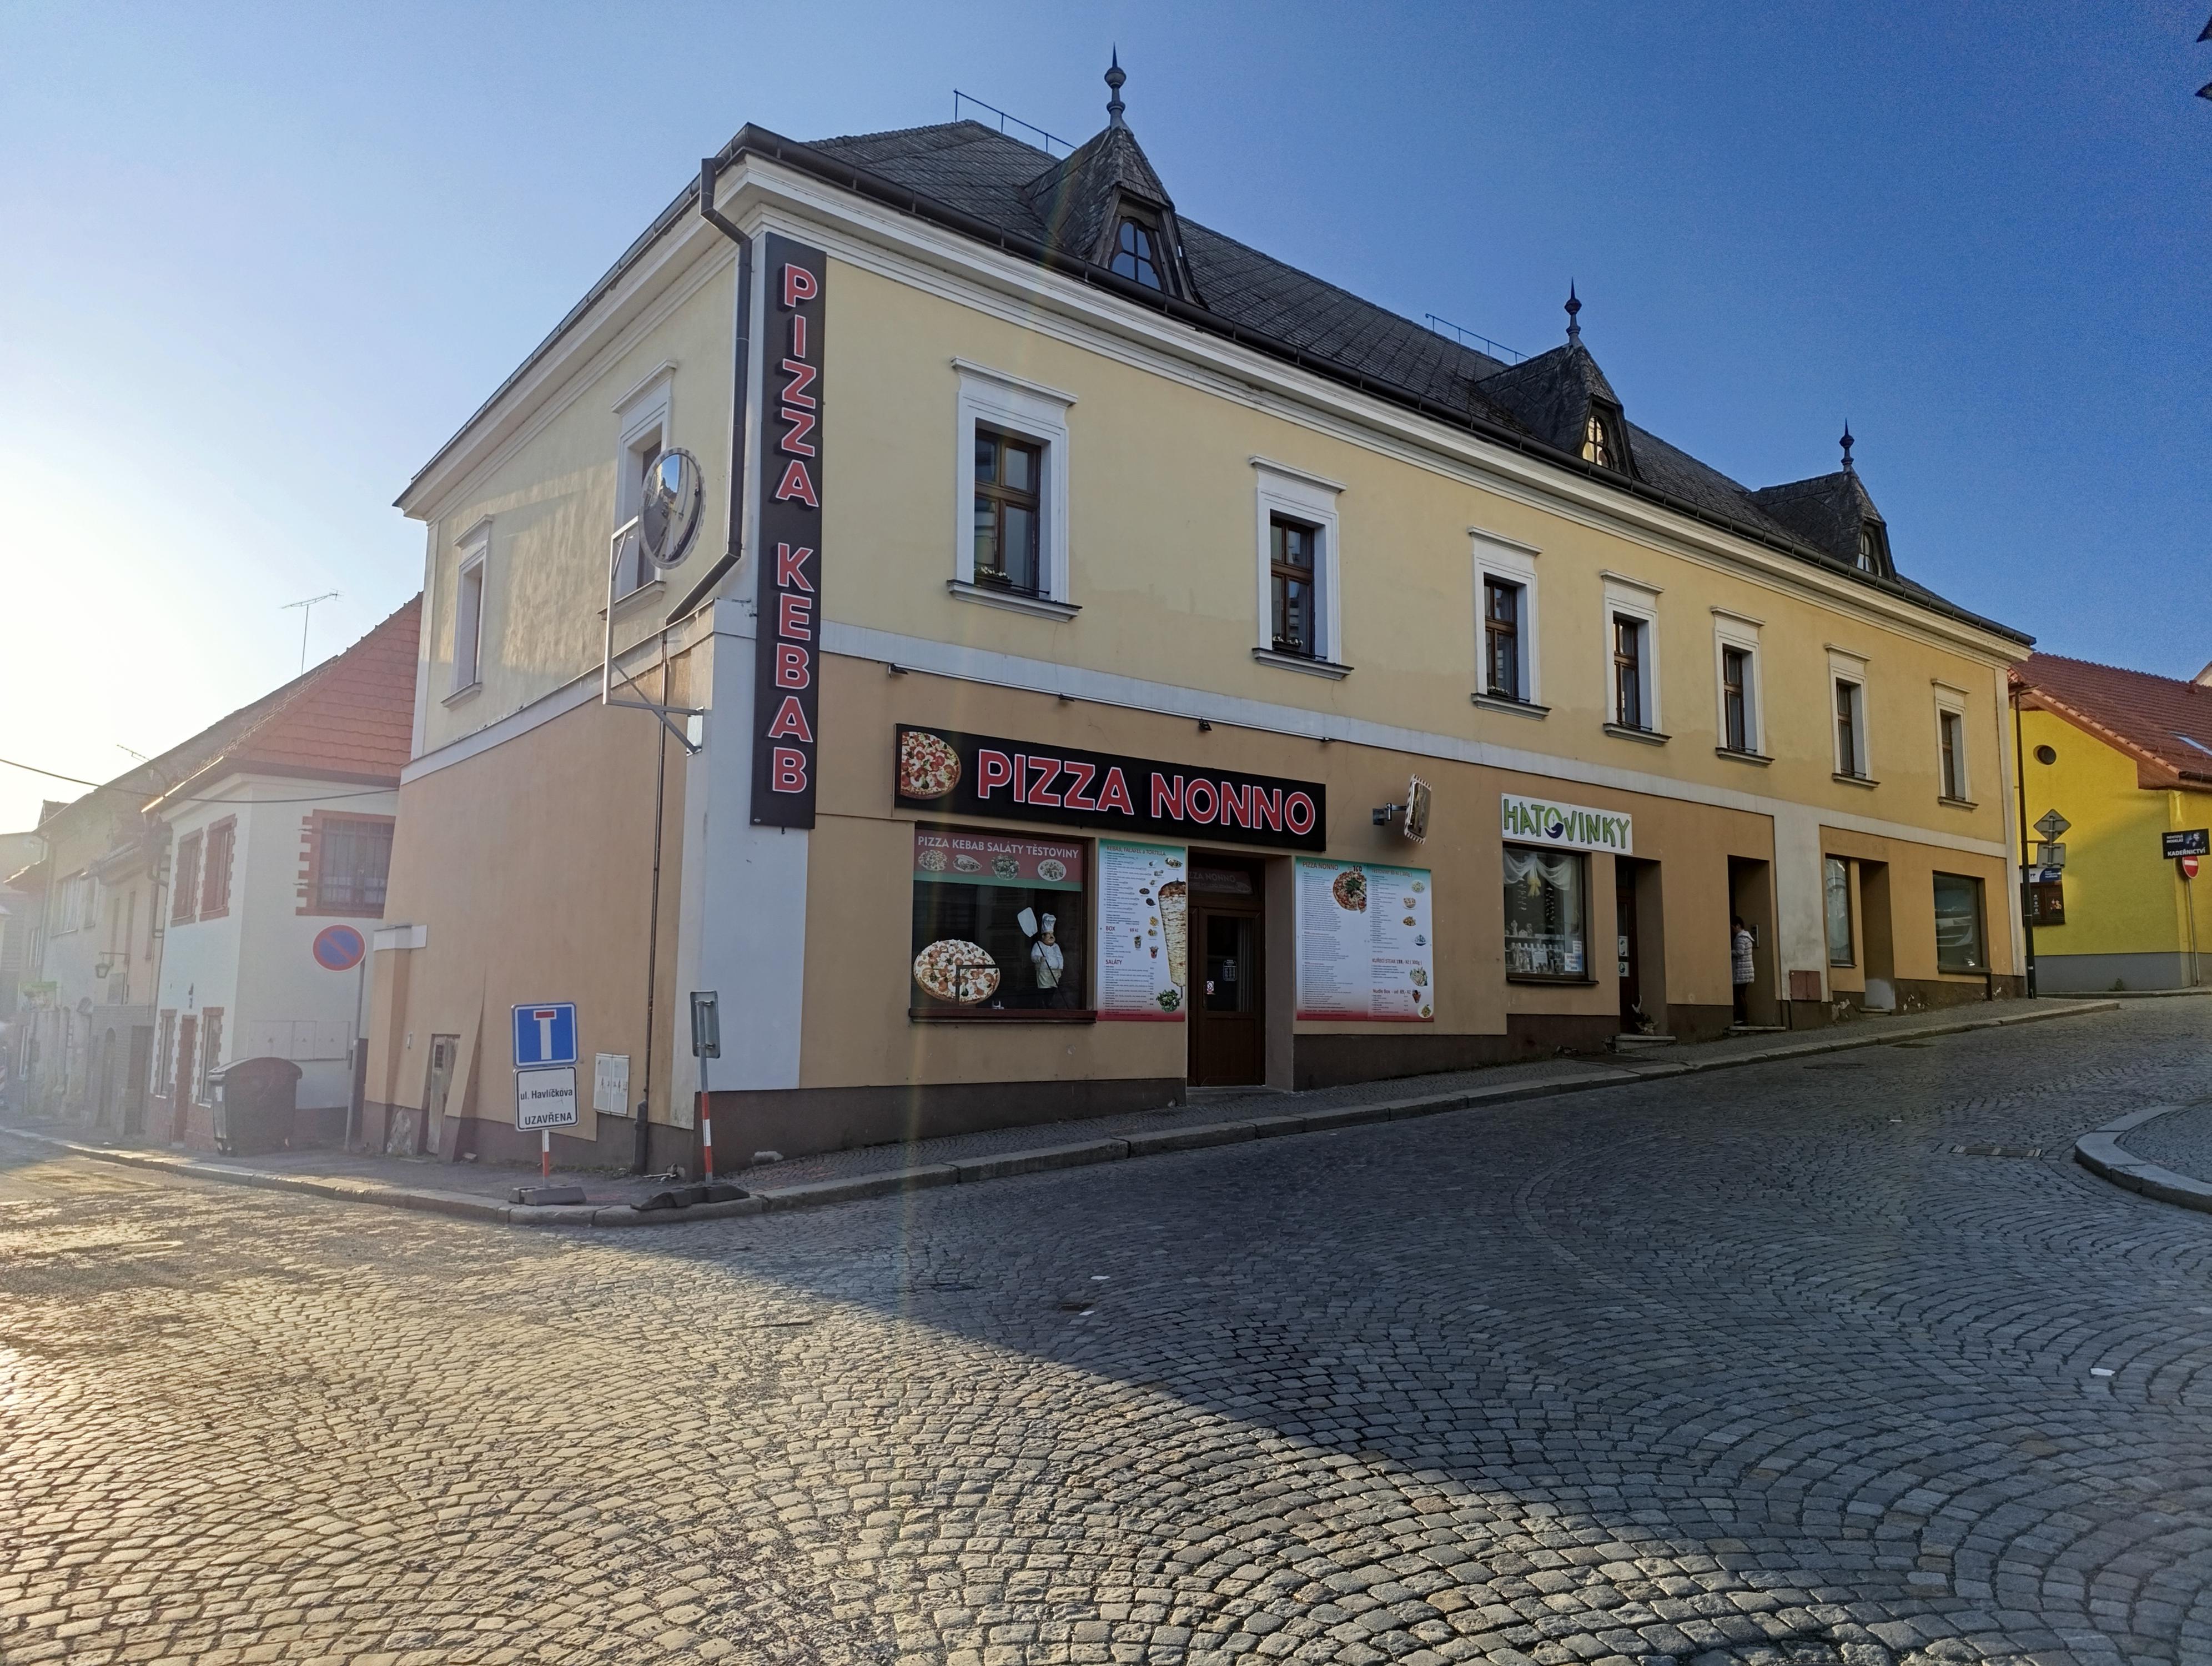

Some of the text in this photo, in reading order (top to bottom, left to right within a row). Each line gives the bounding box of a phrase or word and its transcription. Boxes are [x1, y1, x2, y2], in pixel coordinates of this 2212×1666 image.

[768, 263, 820, 793] PIZZA KEBAB
[978, 748, 1316, 835] PIZZA NONNO
[918, 836, 1079, 859] PIZZA KEBAB SALÁTY TĚSTOVINY
[2167, 847, 2205, 856] KADEŘNICTVÍ
[1188, 871, 1235, 882] ZZA NONNO
[520, 1088, 573, 1100] ul. Havlíčkova
[525, 1112, 572, 1125] UZAVŘENA
